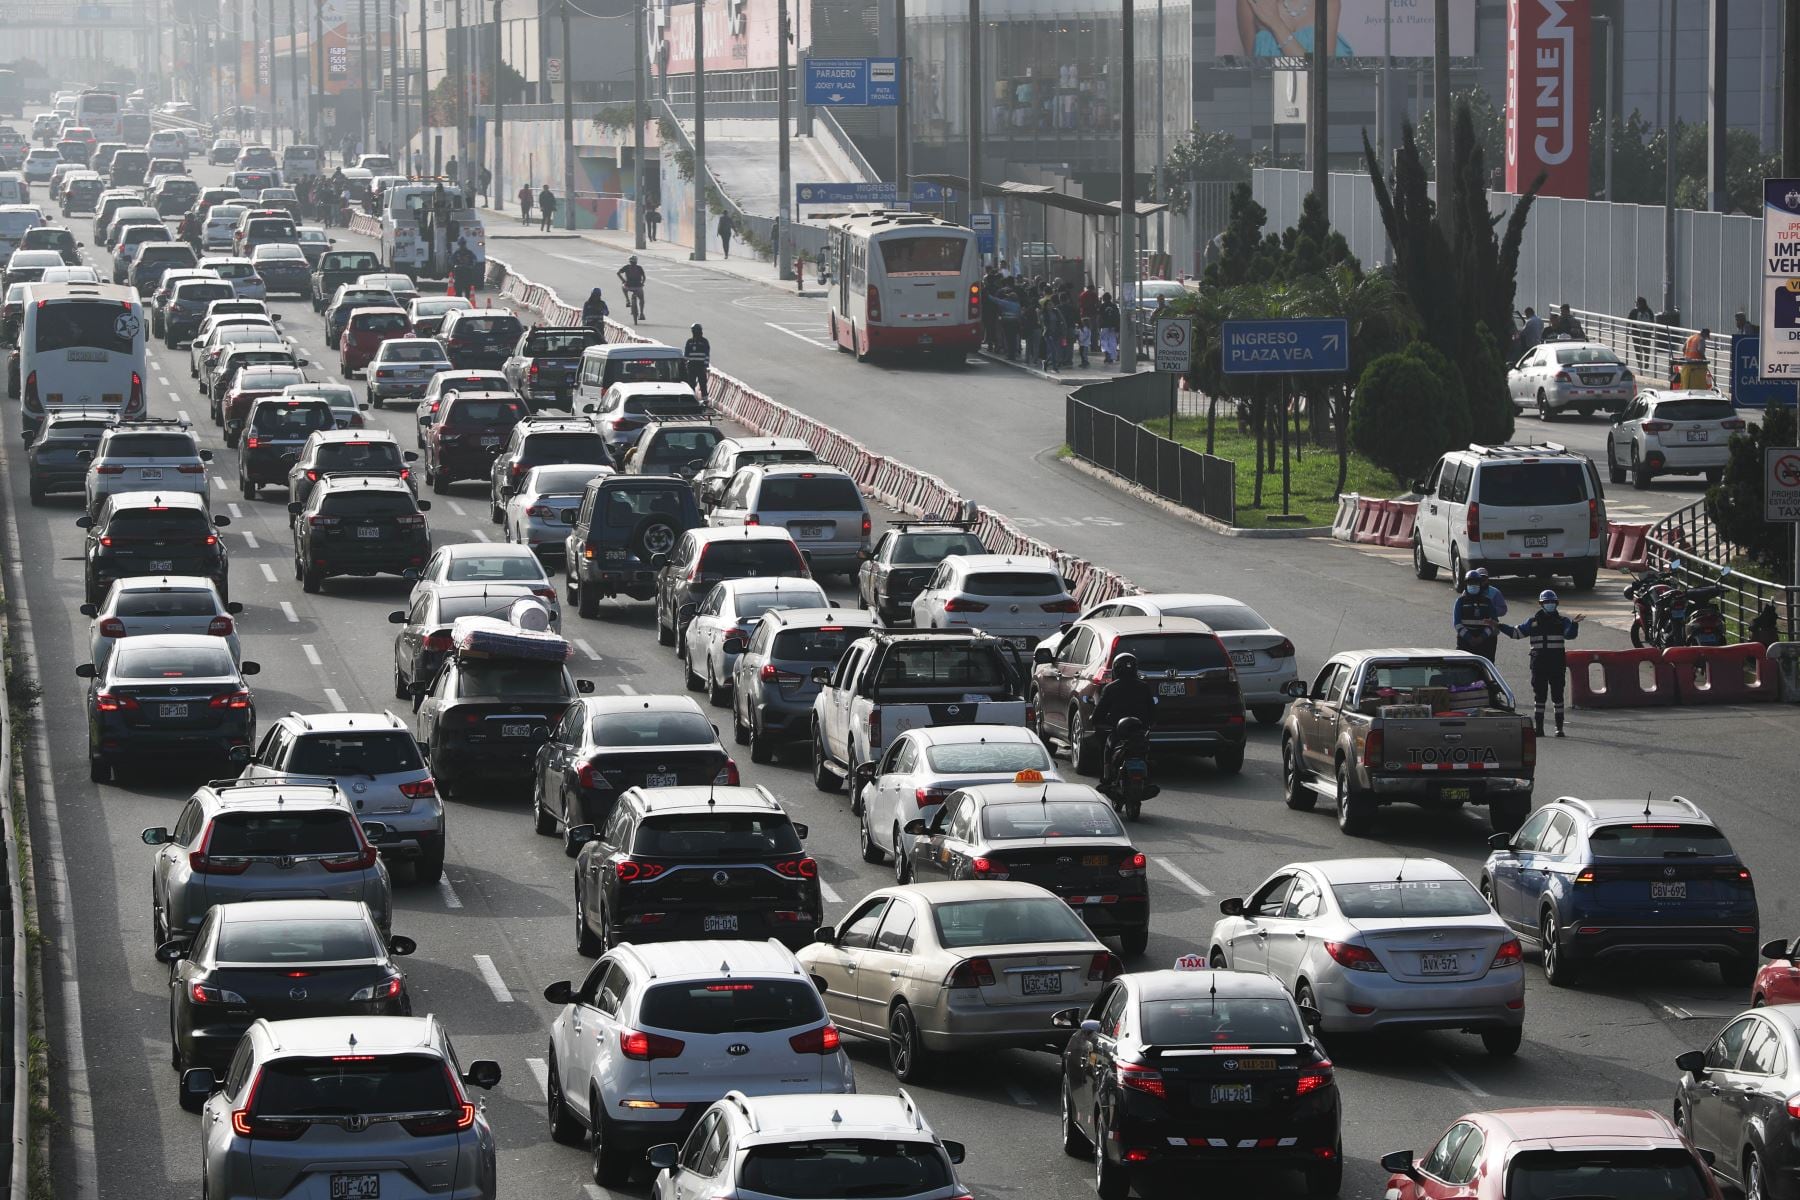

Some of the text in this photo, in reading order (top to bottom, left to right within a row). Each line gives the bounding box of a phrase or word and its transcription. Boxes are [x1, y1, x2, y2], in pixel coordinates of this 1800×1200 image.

[816, 69, 856, 78] PARADERO
[856, 184, 896, 192] INGRESO
[1231, 331, 1298, 346] INGRESO
[1232, 347, 1314, 362] PLAZA VEA
[1161, 361, 1181, 370] TAXI
[1768, 364, 1789, 374] SAT
[1407, 747, 1498, 763] TOYOTA
[1020, 770, 1040, 780] TAXI
[1652, 886, 1686, 897] CBV-692
[705, 919, 738, 930] BPM-014
[1180, 958, 1206, 968] TAXI
[1423, 958, 1458, 970] AVX-571
[1024, 980, 1059, 993] W3C-432
[1211, 1087, 1252, 1102] ALU-281
[333, 1180, 377, 1196] BUF-412
